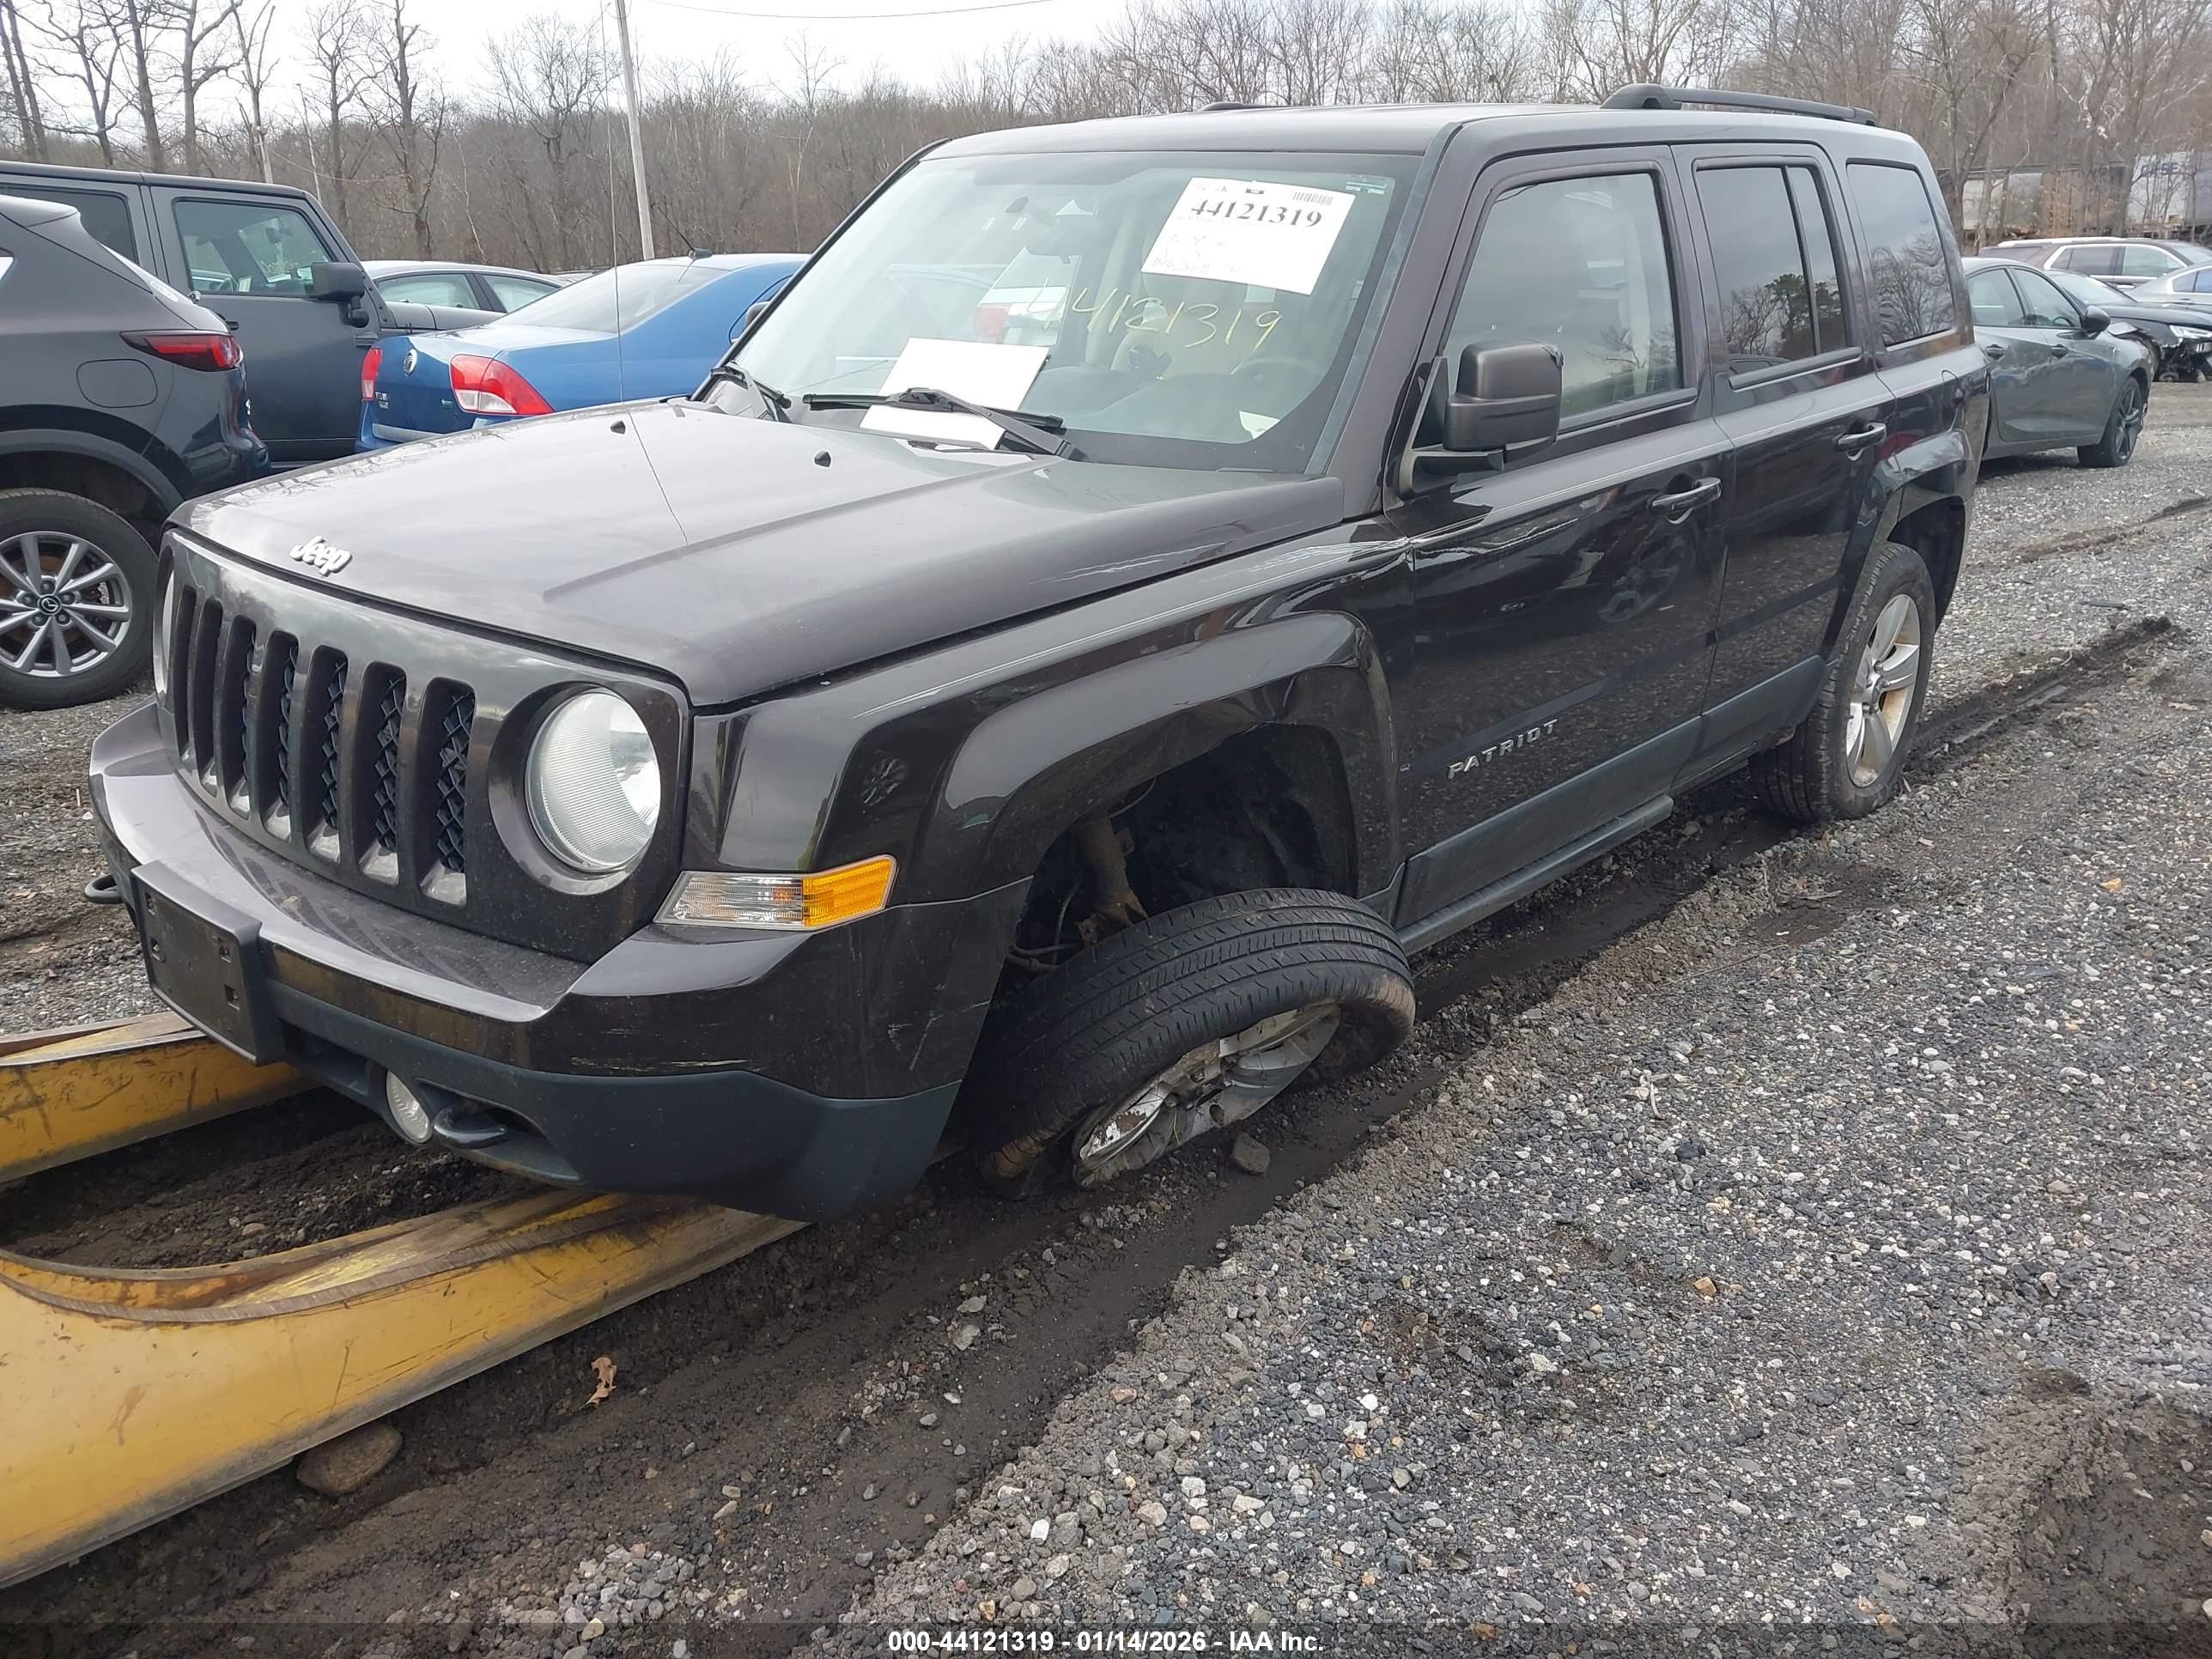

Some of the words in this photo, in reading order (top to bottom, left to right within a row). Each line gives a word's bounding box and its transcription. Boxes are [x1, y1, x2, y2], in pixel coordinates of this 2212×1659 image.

[1191, 199, 1322, 228] 44121319
[1027, 278, 1283, 354] 44121319
[289, 535, 353, 577] Jeep
[1447, 719, 1559, 780] PATRIOT
